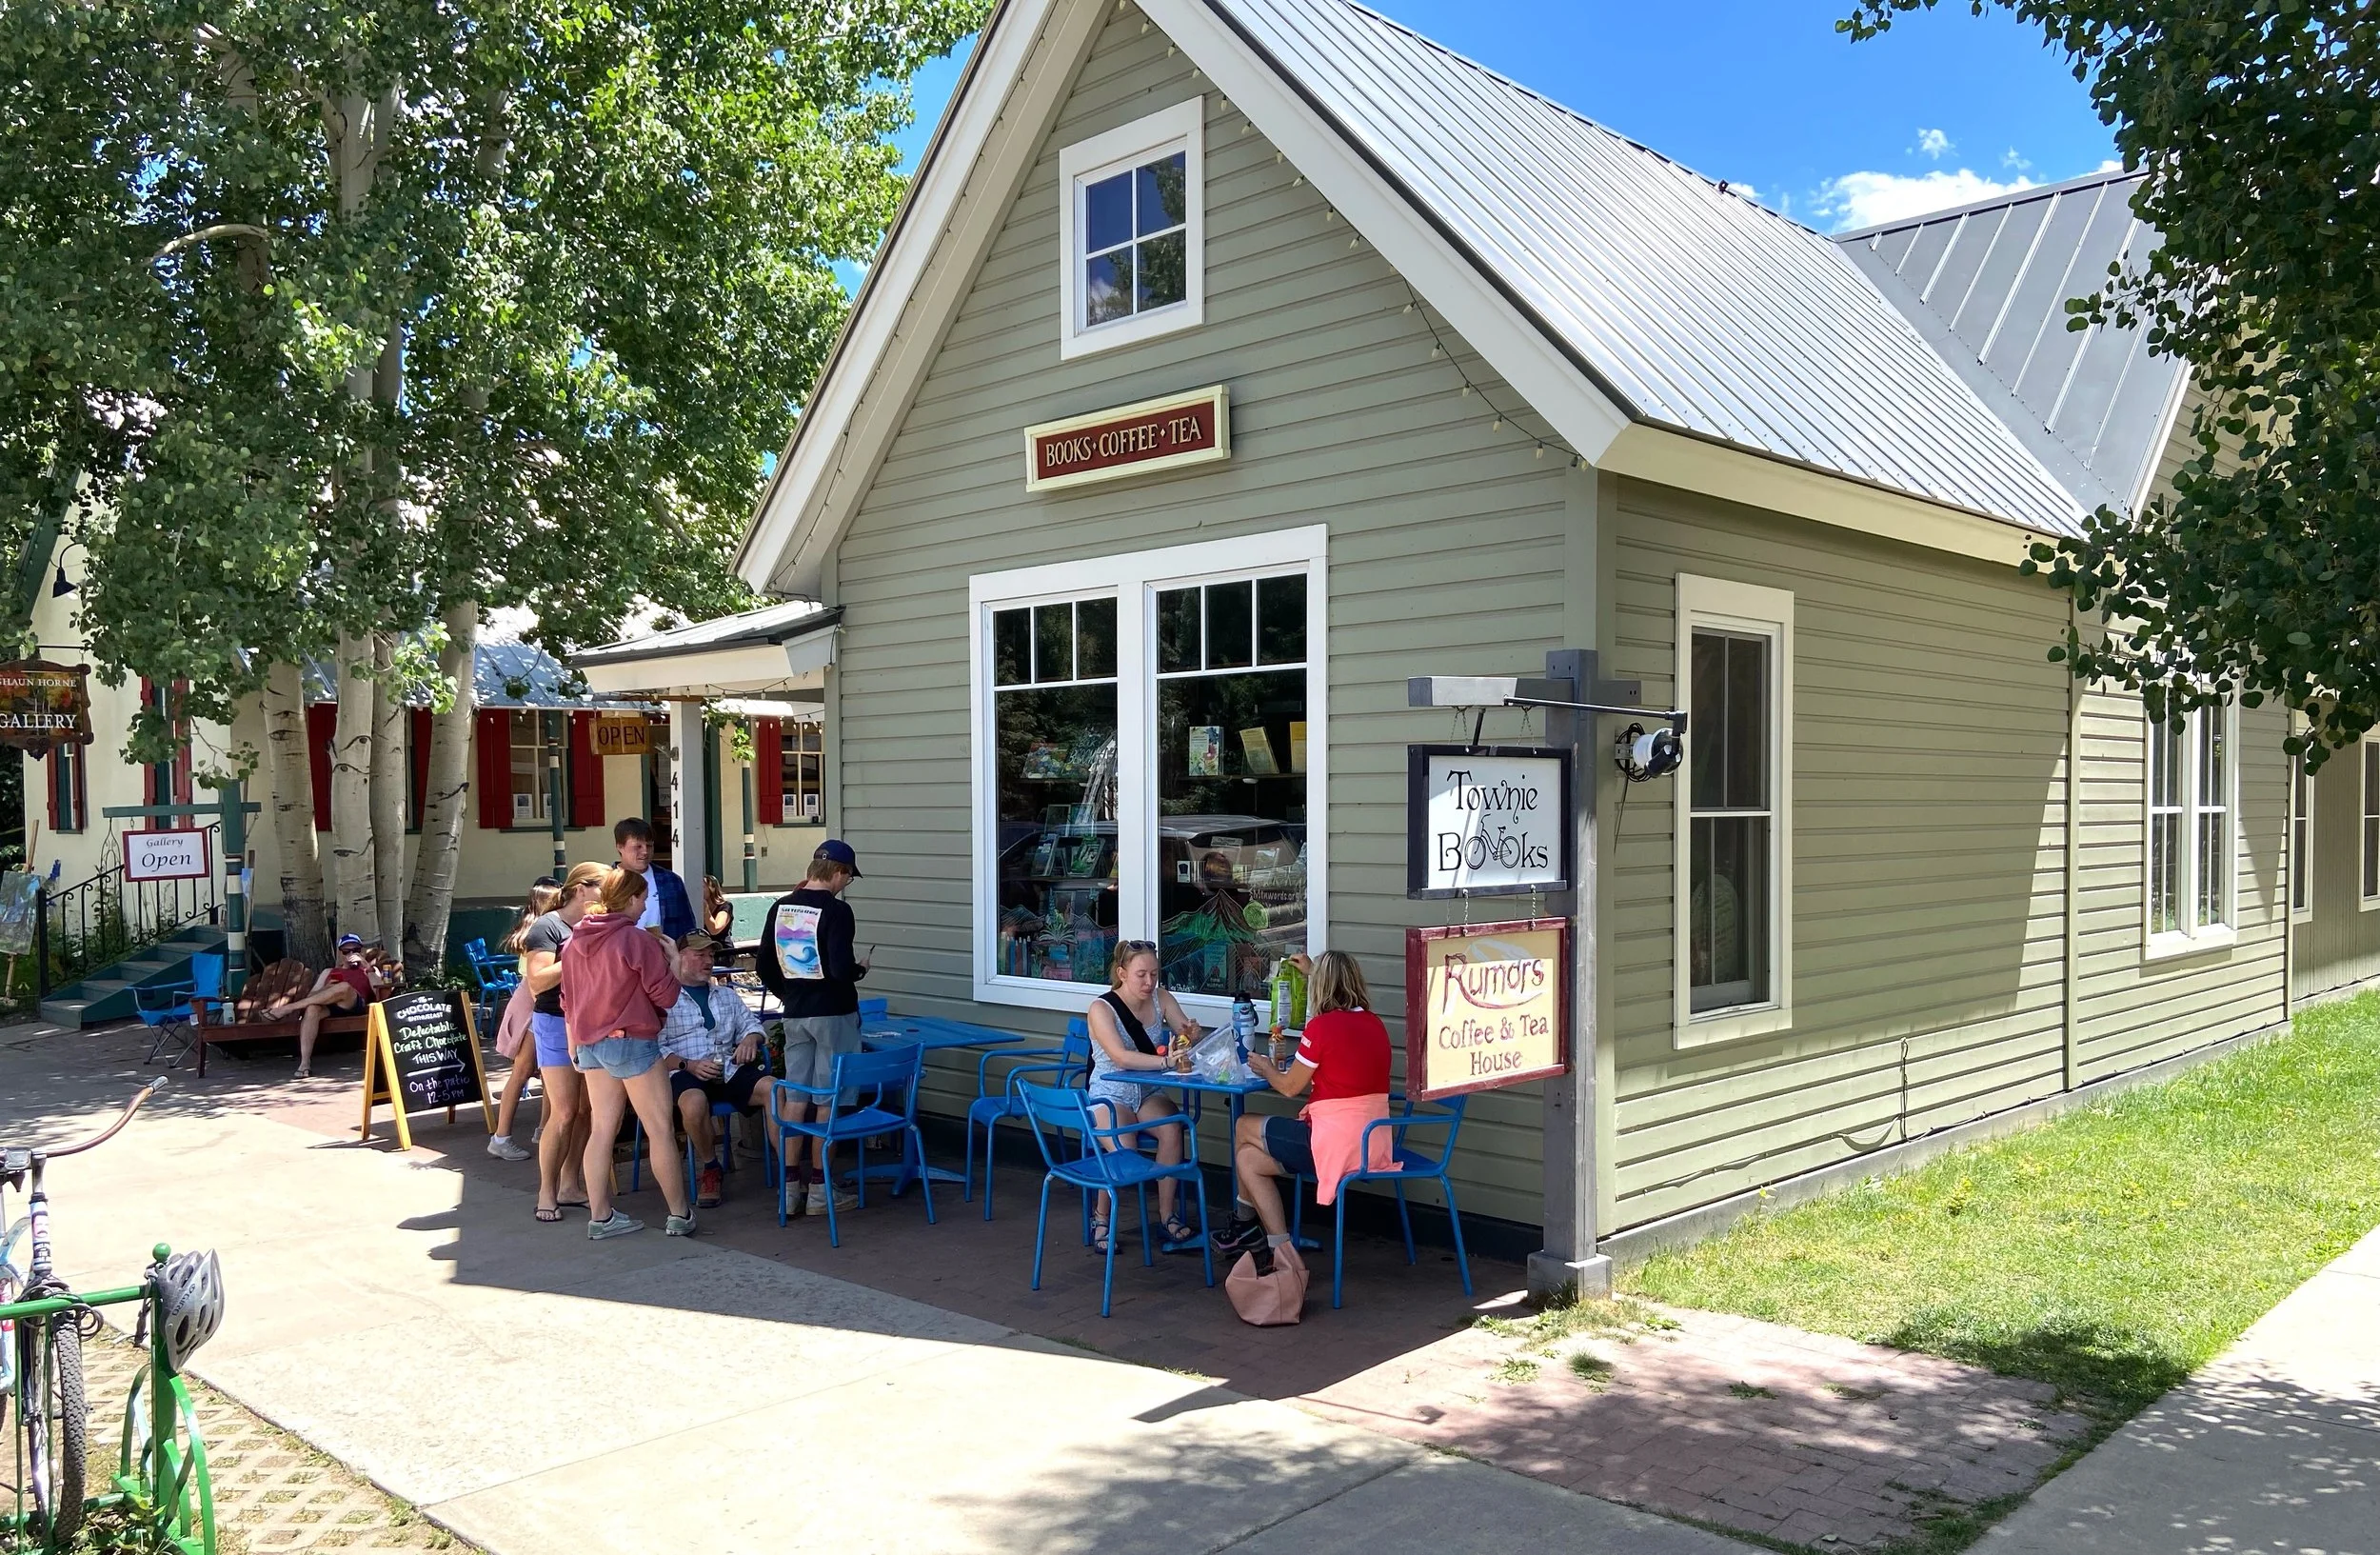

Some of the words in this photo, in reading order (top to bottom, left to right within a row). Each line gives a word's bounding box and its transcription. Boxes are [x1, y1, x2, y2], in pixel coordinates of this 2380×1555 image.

[1045, 436, 1093, 468] BOOKS
[1099, 423, 1159, 458] COFFEE
[1168, 416, 1202, 445] TEA
[38, 679, 77, 688] HORNE
[0, 712, 77, 729] GALLERY
[598, 726, 645, 747] OPEN
[1447, 769, 1538, 824] Townie
[146, 837, 184, 848] Gallery
[1438, 827, 1548, 872] Books
[141, 852, 191, 873] Open
[1443, 952, 1545, 1014] Rumors
[397, 1003, 452, 1019] CHOCOLATE
[407, 1011, 444, 1022] ENTHUSIAST
[398, 1021, 458, 1040] Delectable
[1438, 1018, 1495, 1050] Coffee
[1499, 1016, 1515, 1041] &
[1520, 1012, 1549, 1037] Tea
[426, 1032, 468, 1049] Chocolate
[412, 1051, 436, 1065] THIS
[436, 1048, 458, 1062] WAY
[1470, 1050, 1523, 1076] House
[409, 1081, 425, 1093] On
[426, 1077, 443, 1090] the
[445, 1074, 470, 1090] patio
[426, 1089, 451, 1105] 12-5
